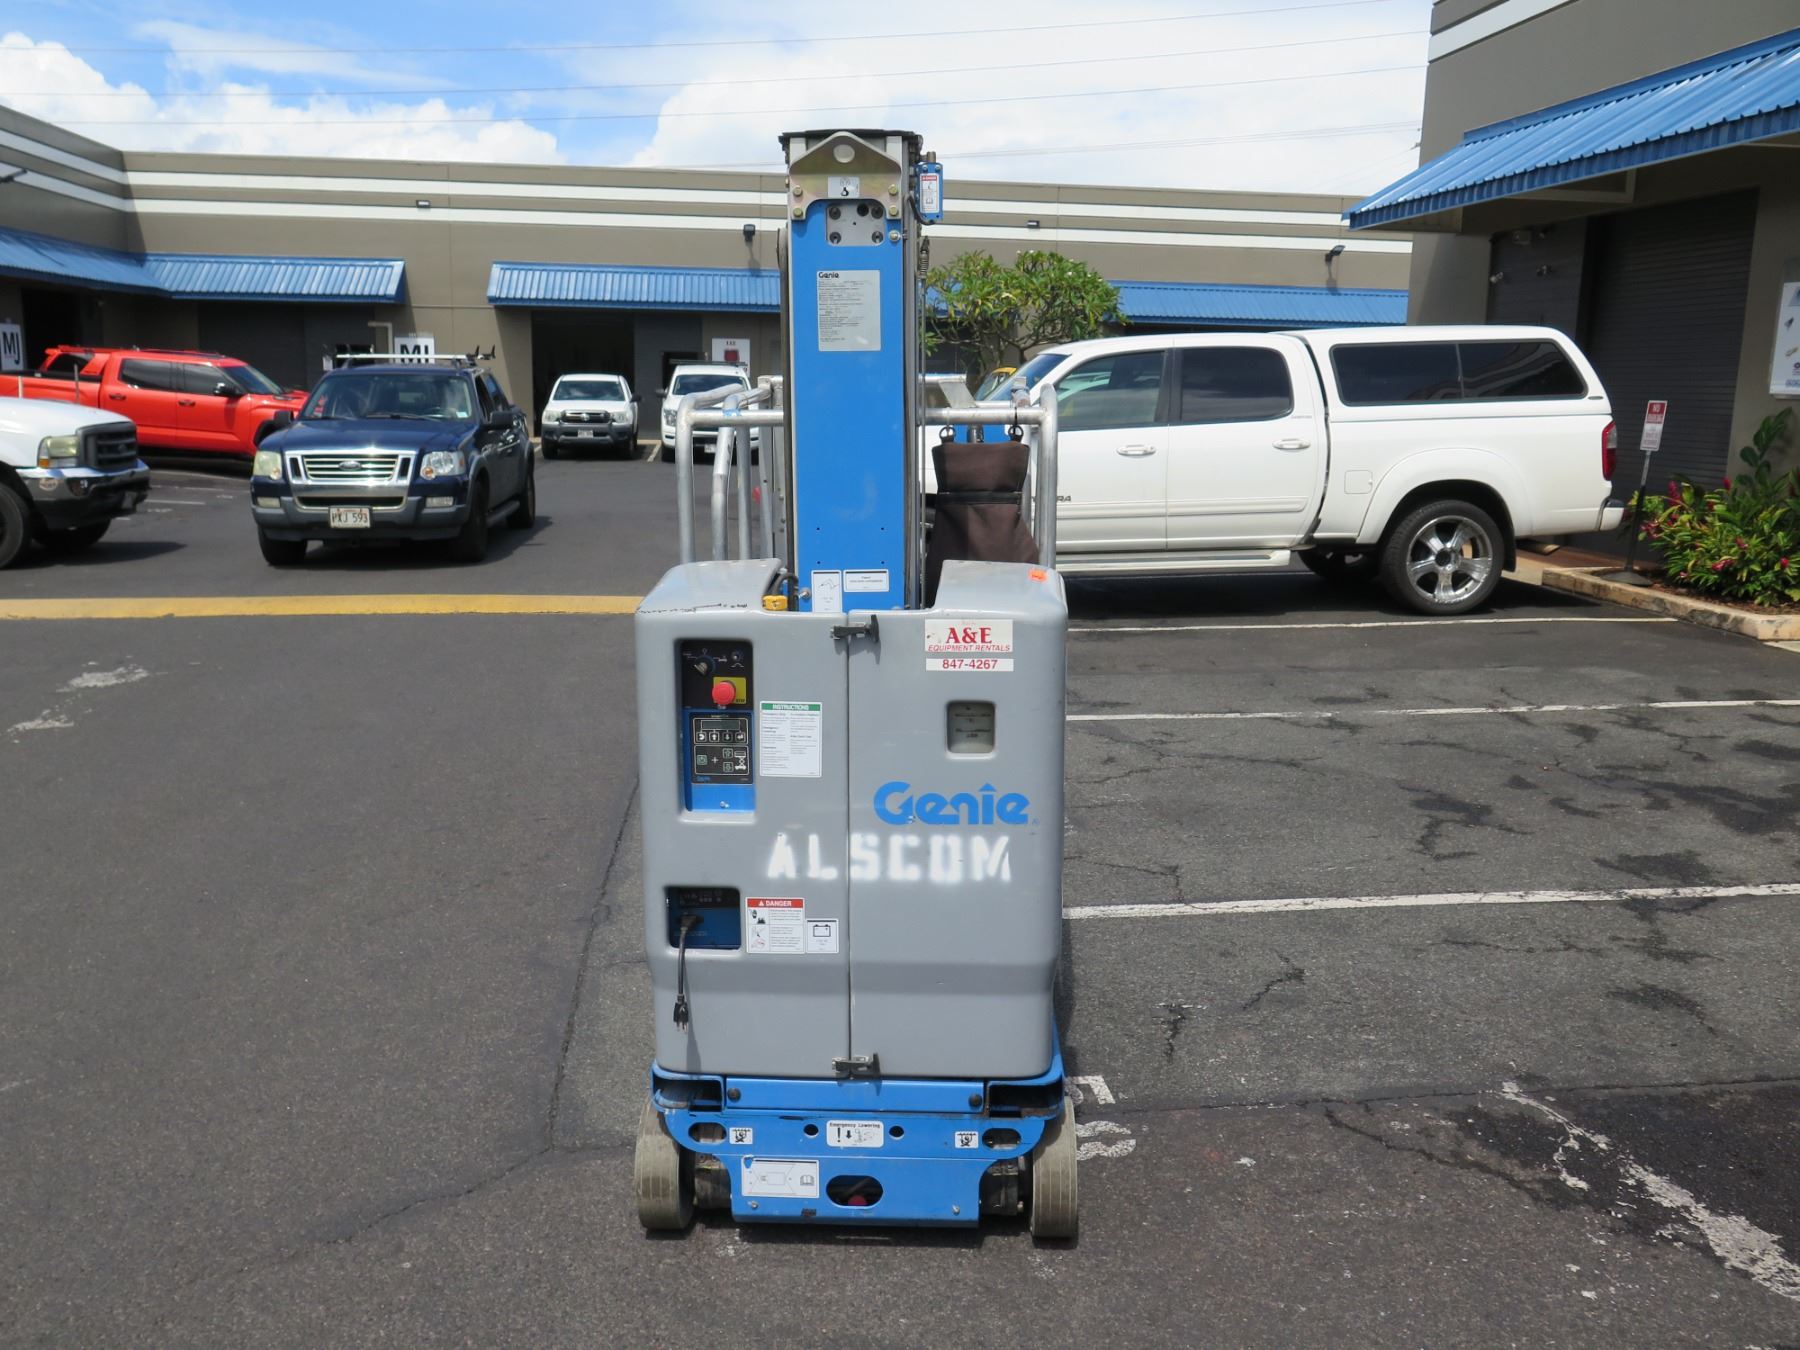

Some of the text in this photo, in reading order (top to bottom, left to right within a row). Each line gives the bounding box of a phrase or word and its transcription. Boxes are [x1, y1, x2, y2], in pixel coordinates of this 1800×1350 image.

[818, 271, 840, 279] Genie
[2, 331, 20, 365] MJ
[945, 627, 992, 644] A&E
[928, 644, 1010, 652] EQUIPMENT RENTALS
[942, 659, 998, 670] 847-4267
[873, 780, 1030, 826] Genie
